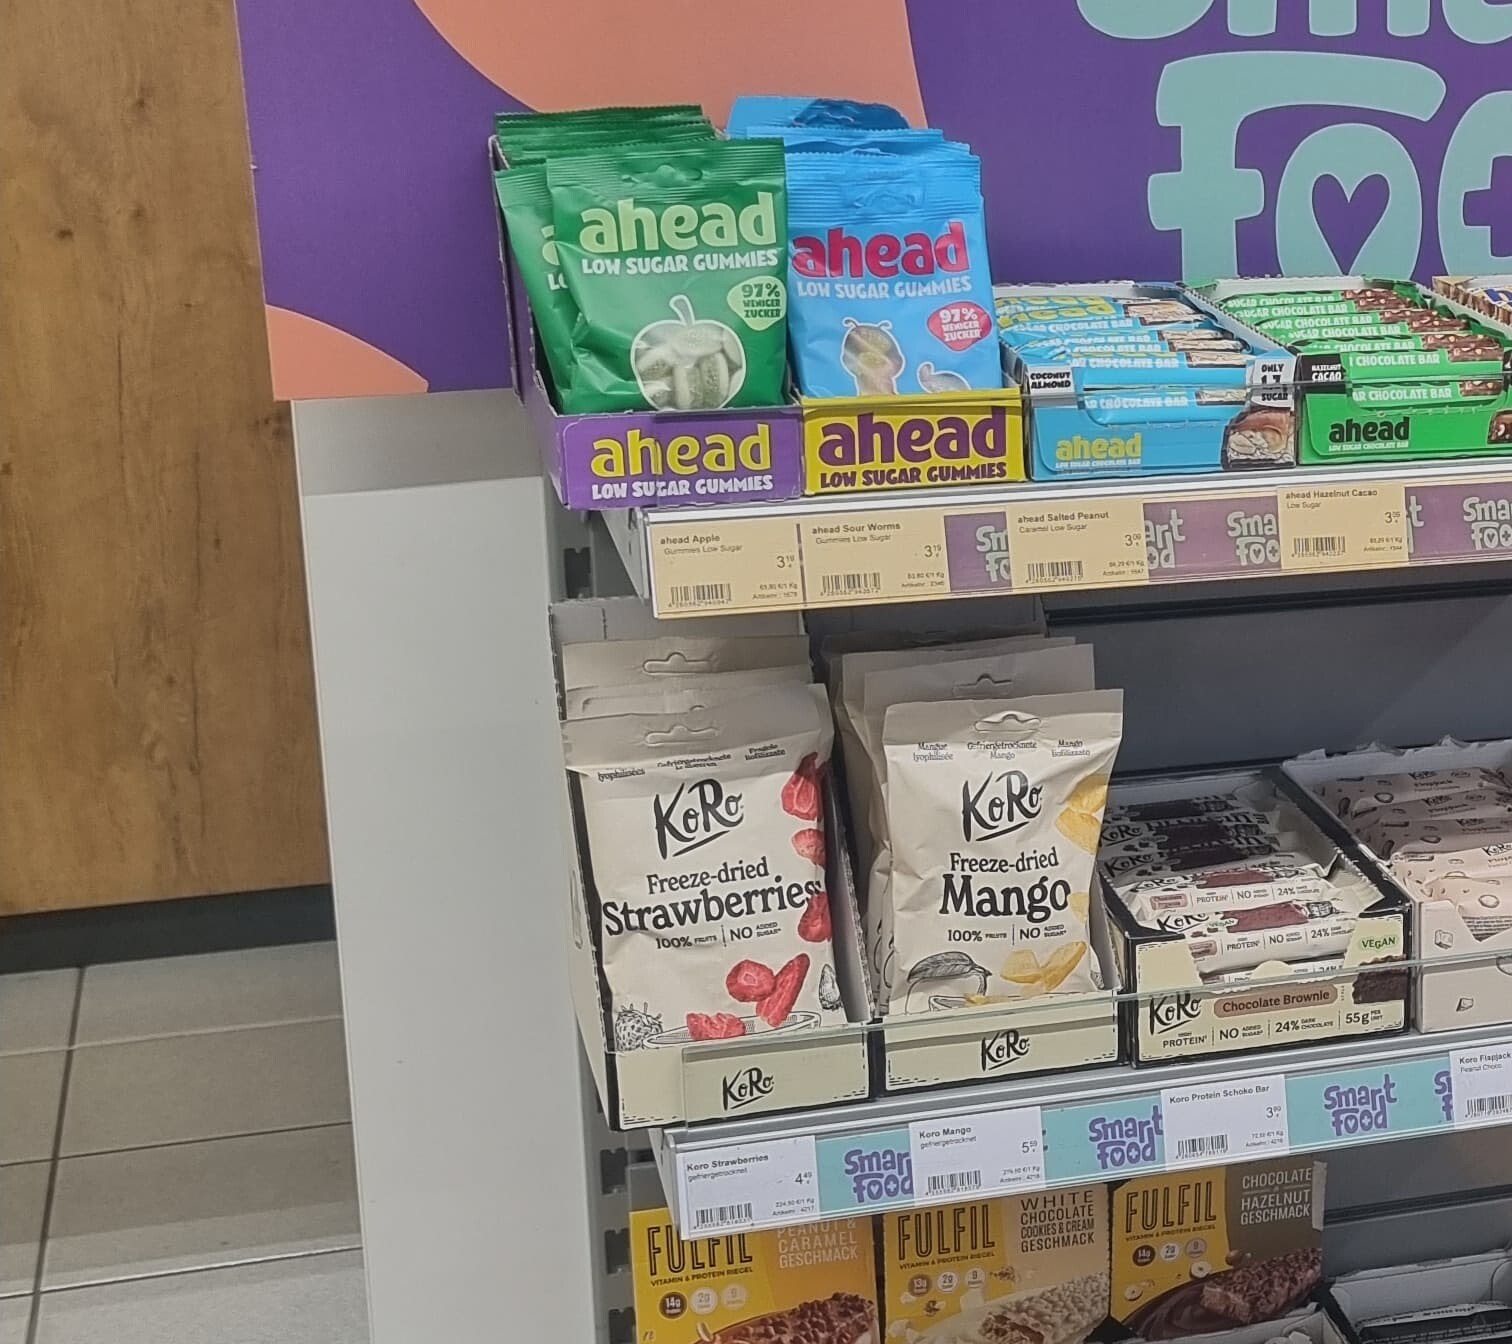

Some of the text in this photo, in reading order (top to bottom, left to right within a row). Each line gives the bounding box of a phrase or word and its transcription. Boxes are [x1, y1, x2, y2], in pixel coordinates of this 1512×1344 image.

[580, 191, 777, 255] ahead
[791, 221, 970, 280] ahead
[581, 248, 778, 277] LOW SUGAR GUMMIES
[740, 282, 781, 299] 97%
[742, 297, 781, 310] WENIGER
[743, 308, 782, 320] ZUCKER
[1030, 370, 1072, 381] COCONUT
[1031, 379, 1073, 391] ALMOND
[1312, 370, 1342, 383] CACAO
[1369, 387, 1452, 402] CHOCOLATE BAR
[819, 407, 1008, 467] ahead
[1328, 416, 1411, 443] ahead
[820, 461, 1007, 489] LOW SUGAR GUMMIES
[1285, 488, 1378, 499] ahead Hazelnut Cacao
[1017, 510, 1109, 523] ahead Salted Peanut
[660, 534, 721, 546] ahead Apple
[719, 544, 743, 555] Sugar
[961, 770, 1043, 842] KoRo
[653, 778, 744, 860] KoRo
[950, 847, 1059, 874] Freeze-dried
[647, 856, 770, 896] Freeze-dried
[602, 876, 824, 936] Strawberries
[939, 873, 1072, 924] Mango
[655, 926, 753, 950] 100% NO
[1361, 935, 1396, 950] VEGAN
[1222, 989, 1331, 1014] Chocolate Brownie
[1219, 1010, 1370, 1041] NO 24% 55g
[980, 1028, 1031, 1072] KoRo
[1170, 1085, 1270, 1105] Koro Protein Schoko Bar
[686, 1154, 769, 1172] Koro Strawberries
[1242, 1167, 1313, 1189] CHOCOLATE
[1020, 1190, 1094, 1212] WHITE
[1125, 1180, 1217, 1234] FULFIL
[1241, 1189, 1311, 1211] HAZELNUT
[1020, 1204, 1094, 1226] CHOCOLATE
[898, 1204, 996, 1261] FULFIL
[1020, 1218, 1095, 1240] COOKIES CREAM
[779, 1232, 857, 1254] CARAMEL
[1020, 1232, 1095, 1253] GESCHMACK
